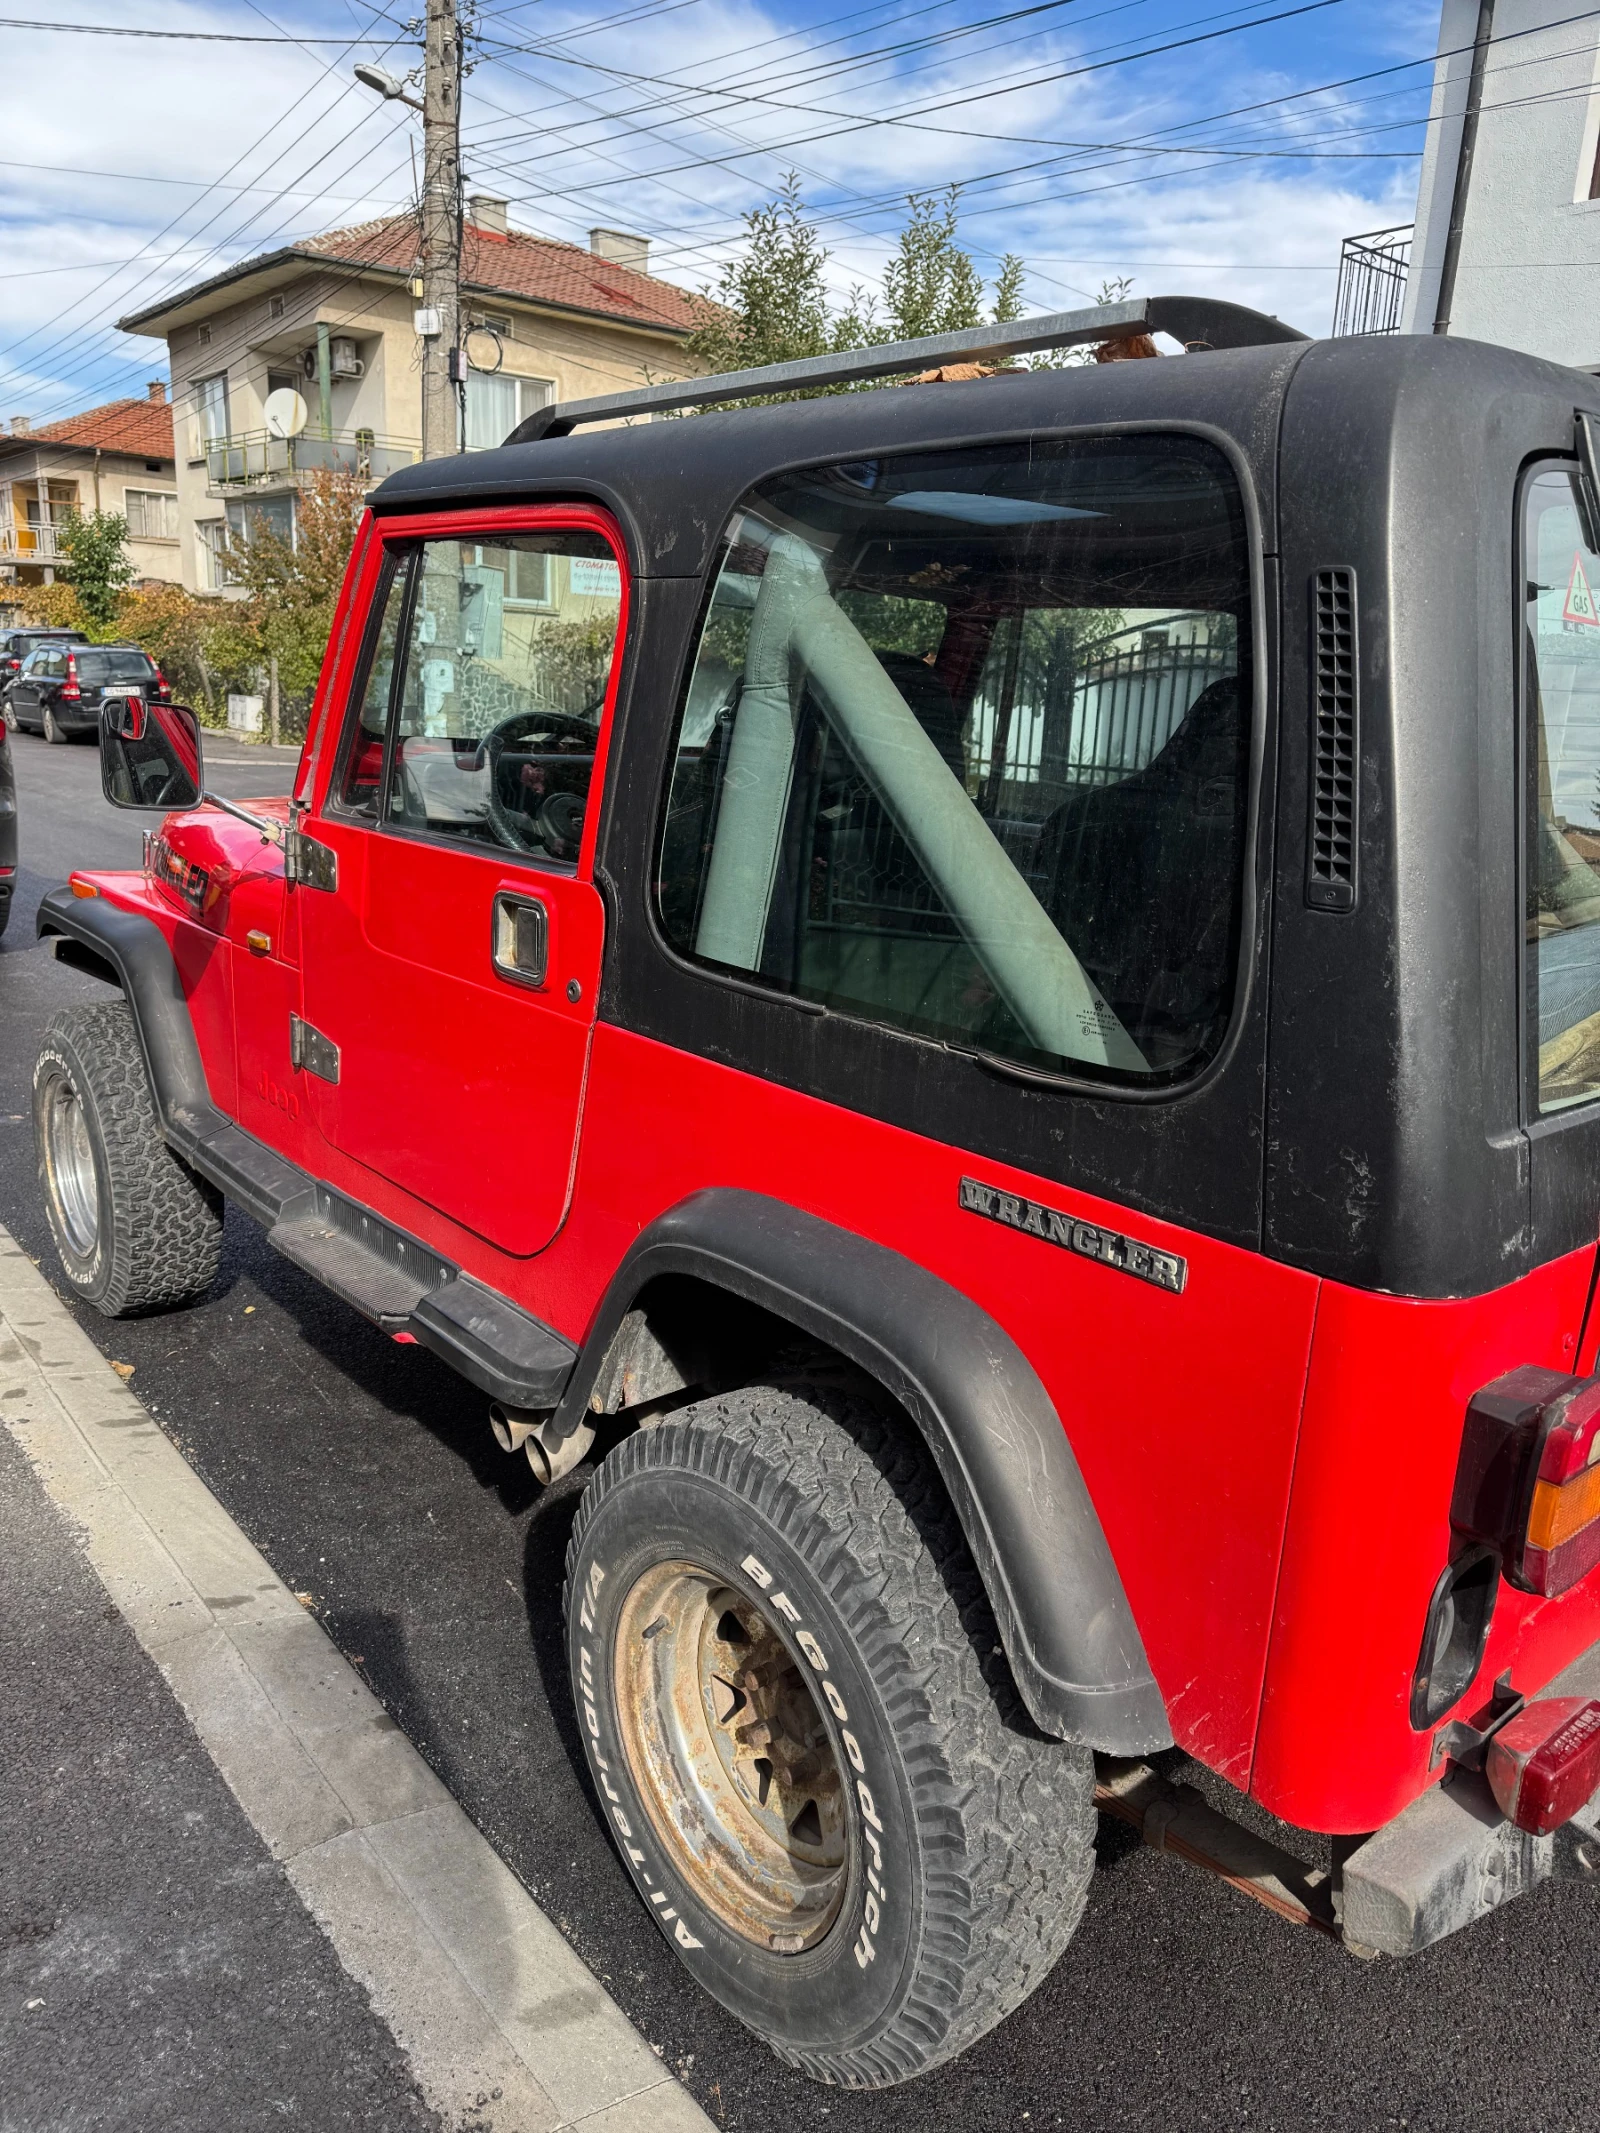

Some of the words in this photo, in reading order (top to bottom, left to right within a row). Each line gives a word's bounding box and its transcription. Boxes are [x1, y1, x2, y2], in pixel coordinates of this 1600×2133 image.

[1573, 594, 1589, 614] GAS
[961, 1180, 1180, 1291] WRANGLER
[580, 1560, 605, 1634] T/A
[580, 1646, 704, 1949] All-Terrain
[740, 1554, 887, 1969] BFGoodrich
